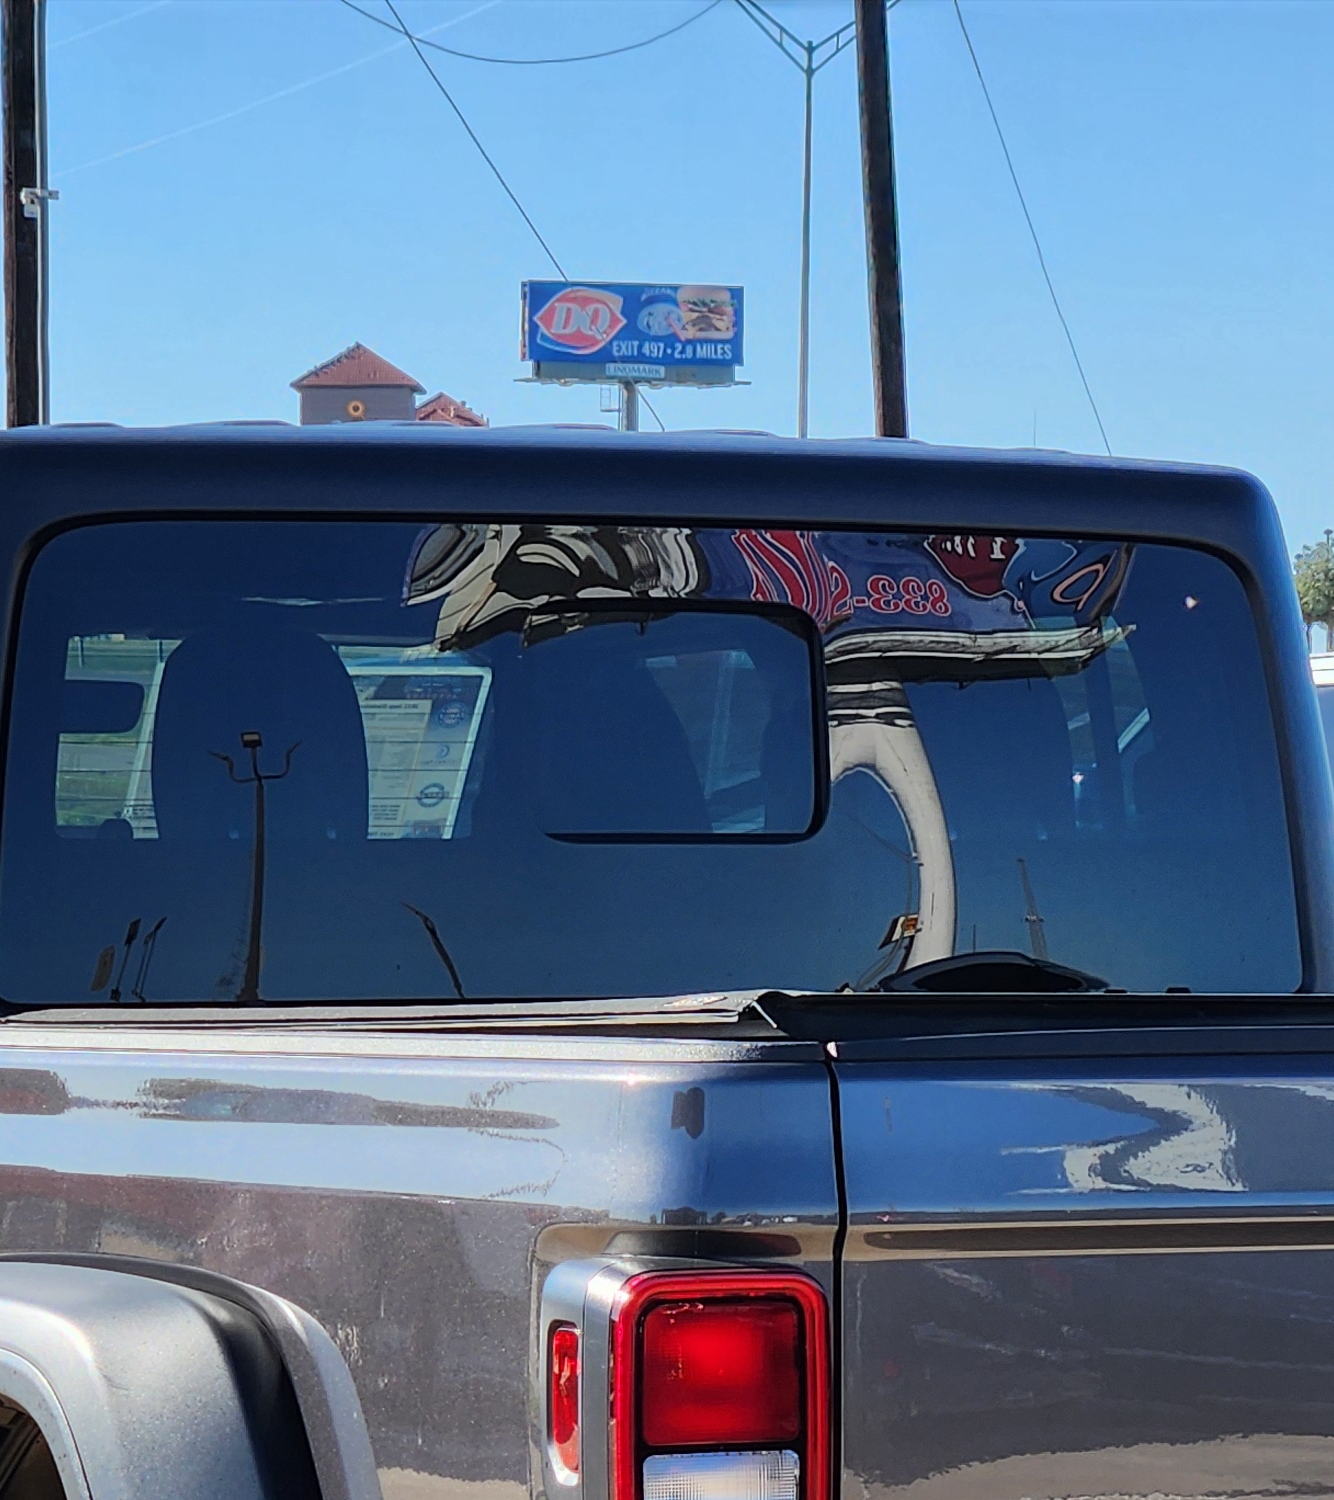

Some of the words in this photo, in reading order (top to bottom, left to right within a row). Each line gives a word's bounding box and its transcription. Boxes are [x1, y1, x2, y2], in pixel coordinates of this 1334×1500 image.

[551, 303, 611, 340] DQ
[612, 340, 640, 357] EXIT
[642, 342, 665, 358] 497
[696, 345, 732, 359] MILES
